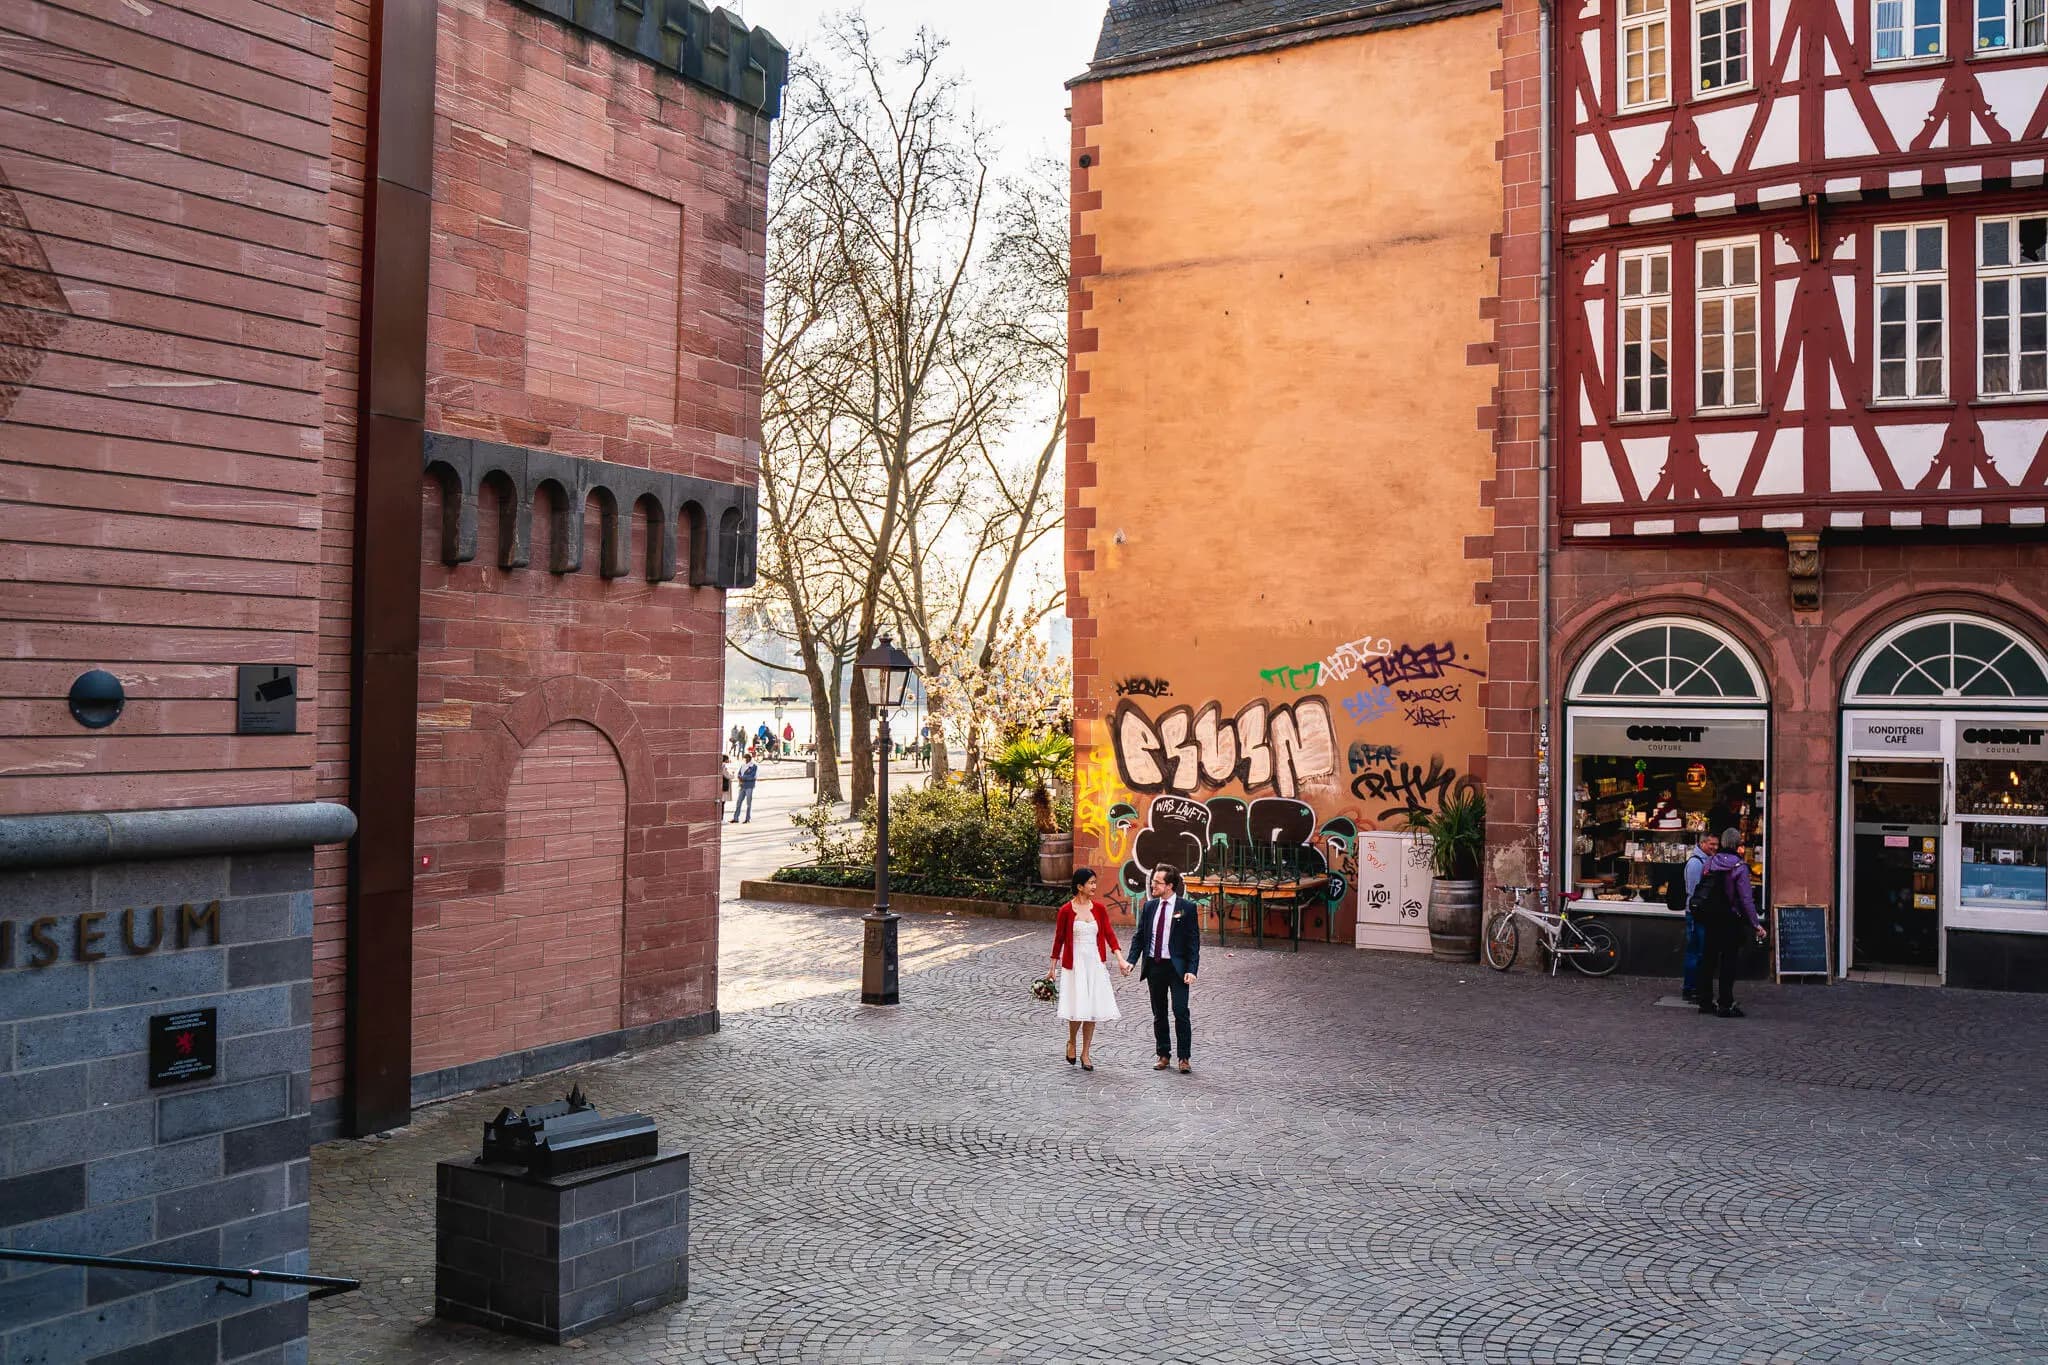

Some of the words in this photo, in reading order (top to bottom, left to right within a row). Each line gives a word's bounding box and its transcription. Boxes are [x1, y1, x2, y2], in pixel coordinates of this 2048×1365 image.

[1868, 726, 1924, 735] KONDITOREI
[1884, 734, 1907, 744] CAFÉ
[1648, 744, 1683, 752] COUTURE
[1155, 799, 1175, 813] WAS
[1175, 801, 1207, 821] LÄUFT
[0, 900, 221, 969] SEUM
